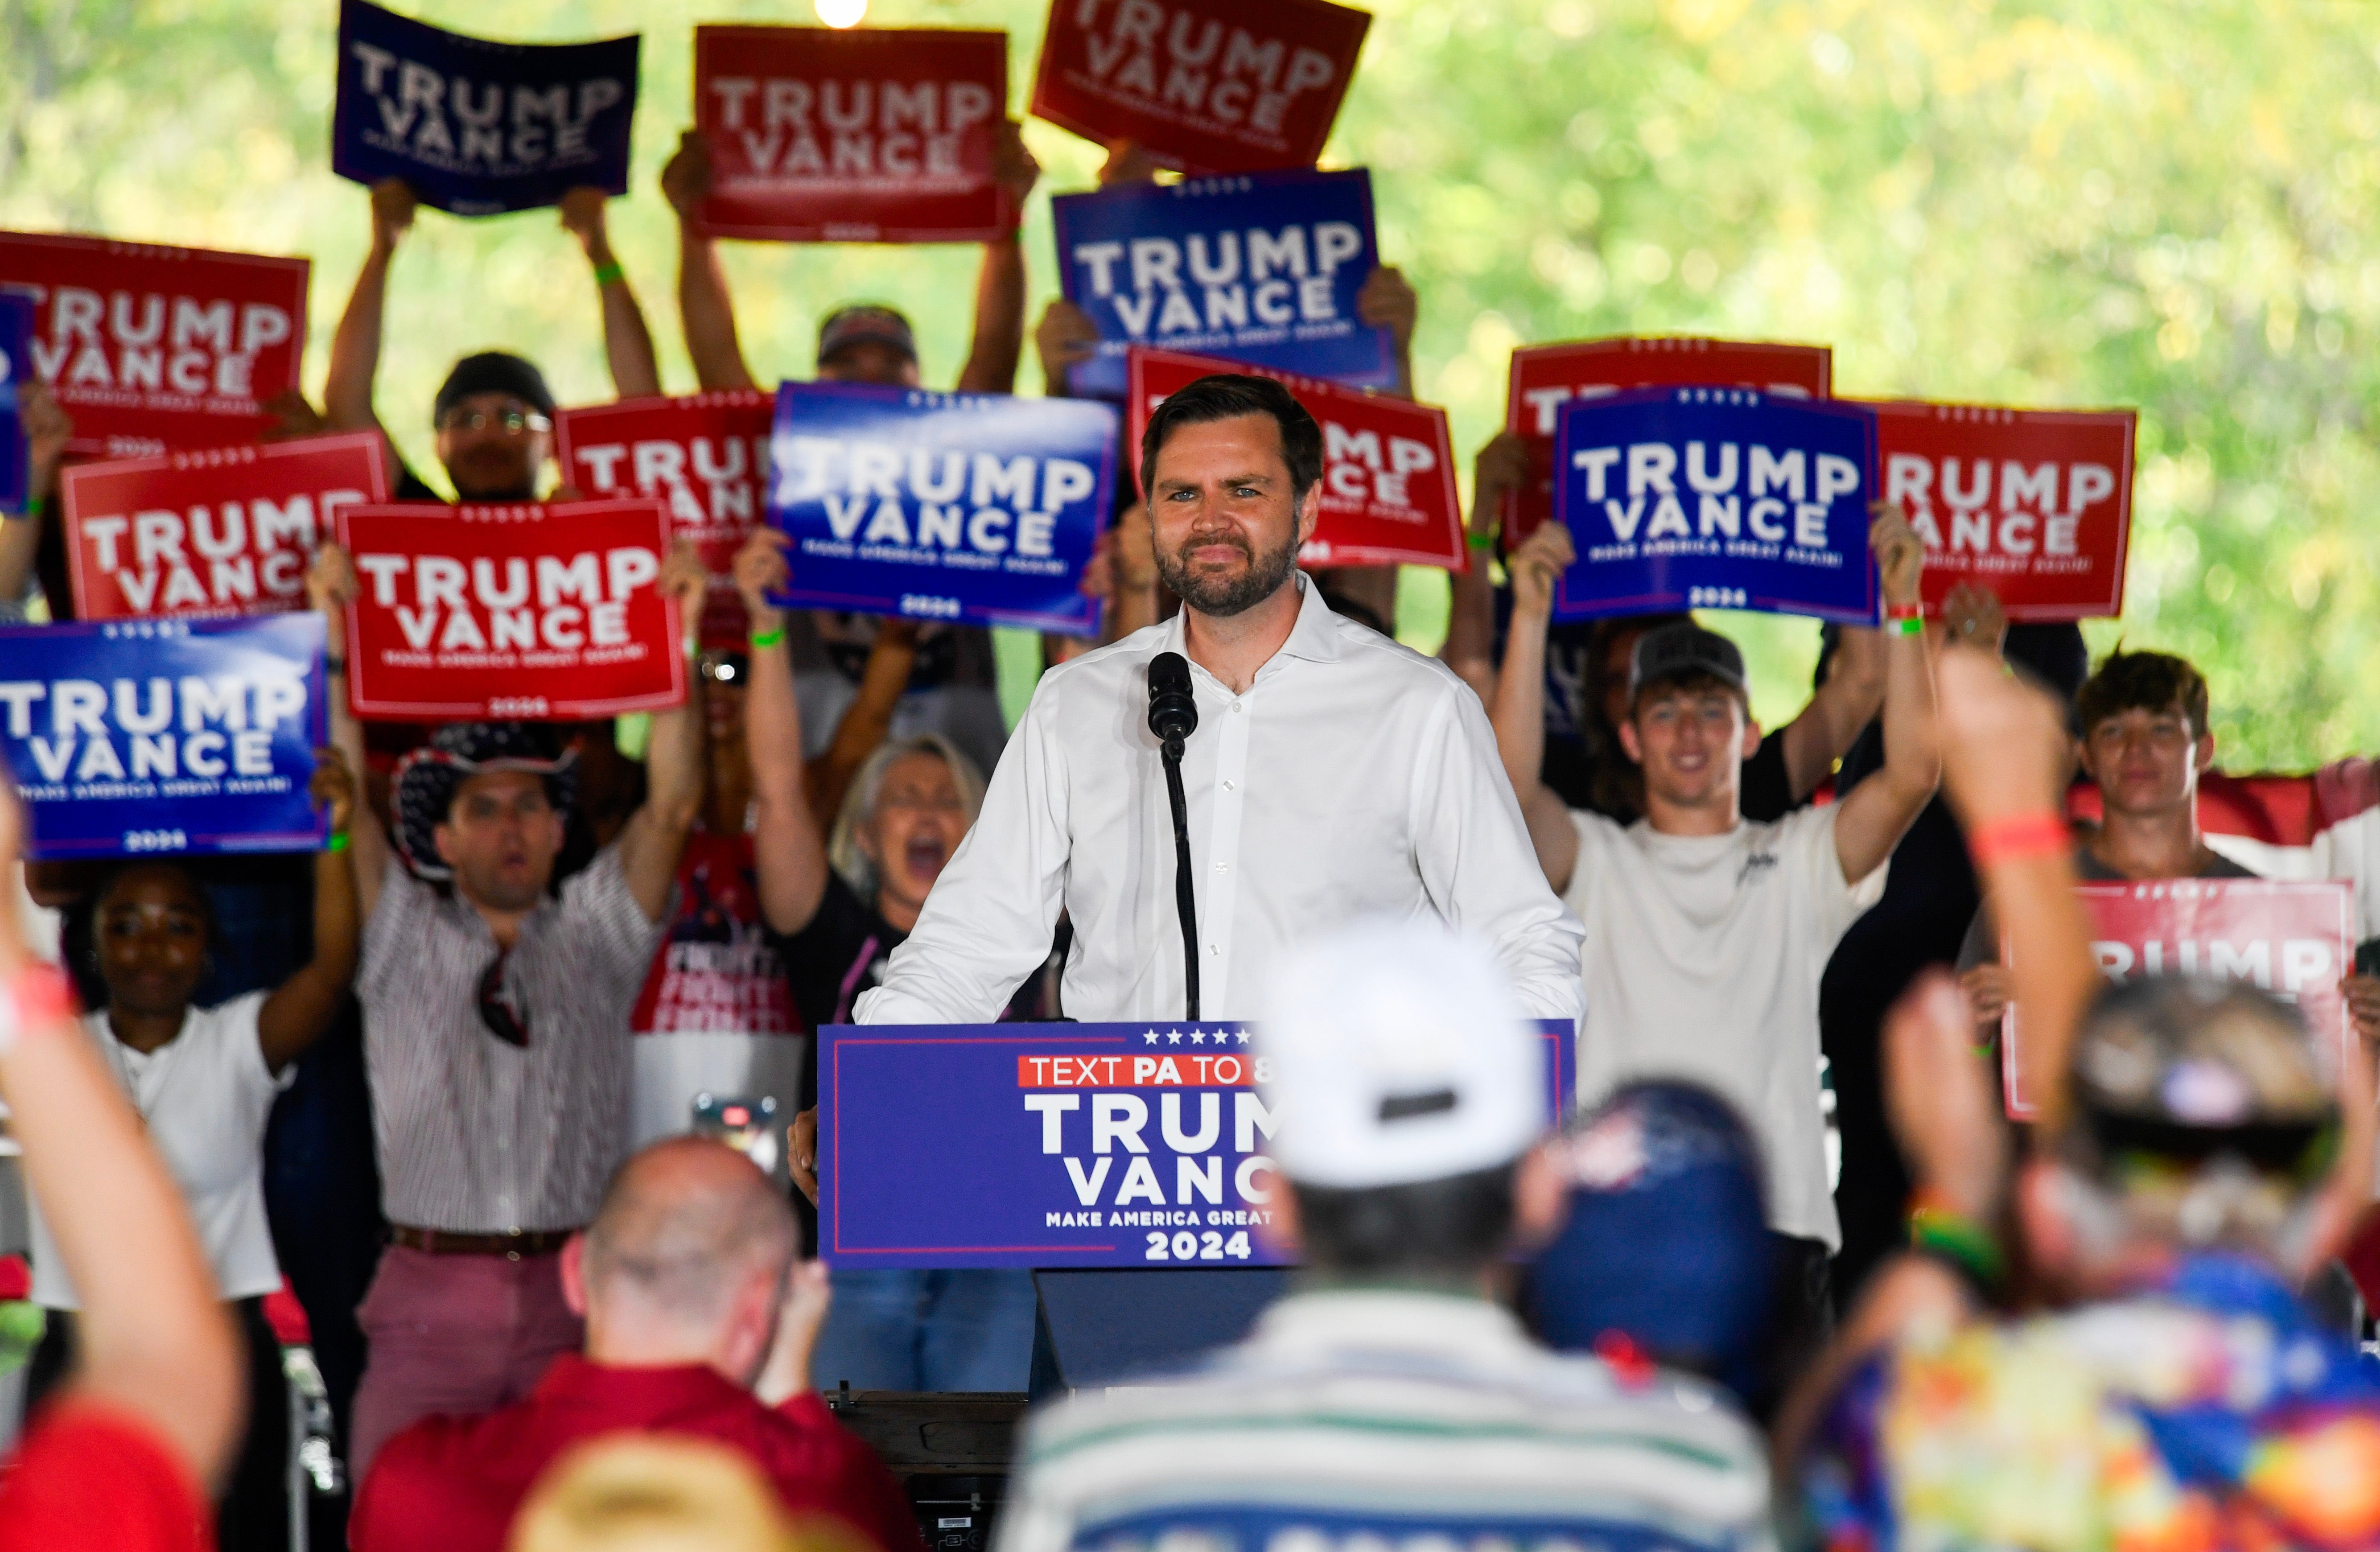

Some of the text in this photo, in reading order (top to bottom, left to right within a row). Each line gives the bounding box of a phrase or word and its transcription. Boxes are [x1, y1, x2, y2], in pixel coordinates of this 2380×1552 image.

[353, 41, 623, 125] TRUMP
[712, 76, 993, 132] TRUMP
[1083, 30, 1292, 135] VANCE
[379, 96, 585, 163] VANCE
[740, 128, 963, 176] VANCE
[1074, 221, 1363, 297] TRUMP
[1113, 274, 1338, 338] VANCE
[30, 338, 255, 396] VANCE
[576, 435, 770, 493] TRU
[796, 438, 1095, 513] TRUMP
[1572, 441, 1860, 506] TRUMP
[1886, 452, 2115, 514] RUMP
[823, 494, 1057, 557] VANCE
[1605, 494, 1830, 549] VANCE
[1910, 509, 2079, 556] ANCE
[117, 550, 302, 613] VANC
[358, 546, 659, 609] TRUMP
[395, 601, 630, 651] VANCE
[0, 675, 308, 739] TRUMP
[29, 731, 275, 782] VANCE
[2089, 939, 2332, 992] RUMP
[1029, 1057, 1122, 1085] TEXT
[1134, 1057, 1182, 1084] PA
[1193, 1056, 1241, 1084] TO
[1025, 1092, 1286, 1154] TRUM
[1063, 1156, 1276, 1206] VANC
[1046, 1210, 1272, 1227] MAKE AMERICA GREAT
[1145, 1231, 1251, 1260] 2024
